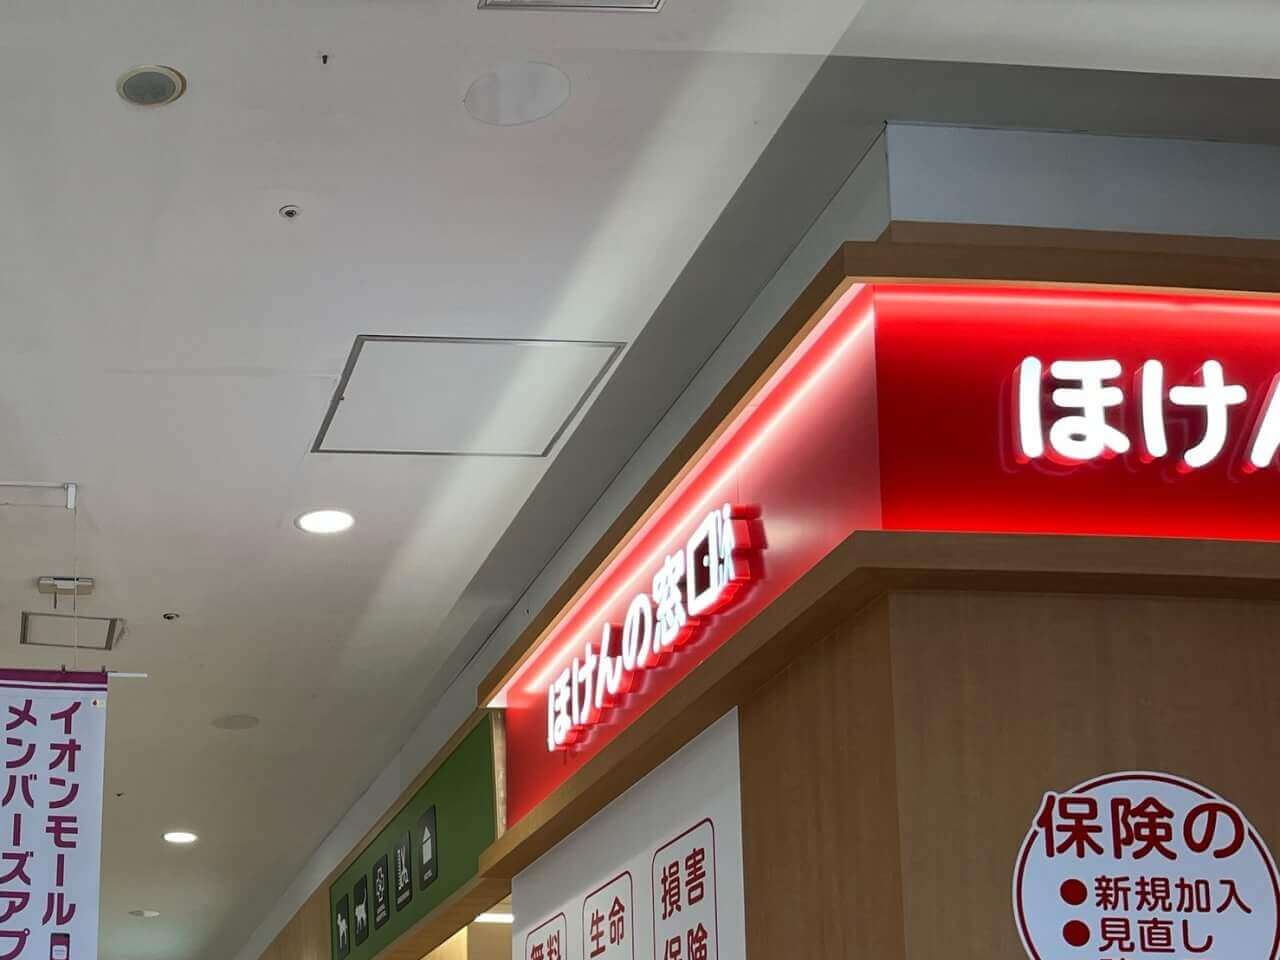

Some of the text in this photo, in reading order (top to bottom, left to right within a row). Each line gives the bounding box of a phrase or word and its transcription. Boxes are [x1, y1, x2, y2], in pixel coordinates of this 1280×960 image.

[548, 504, 734, 751] ほけんの窓口
[42, 701, 82, 926] イオンモール
[1036, 795, 1245, 861] 保険の
[661, 847, 707, 921] 損害
[1094, 875, 1252, 914] 新規加入
[589, 896, 625, 959] 生命
[1098, 917, 1213, 953] 見直し
